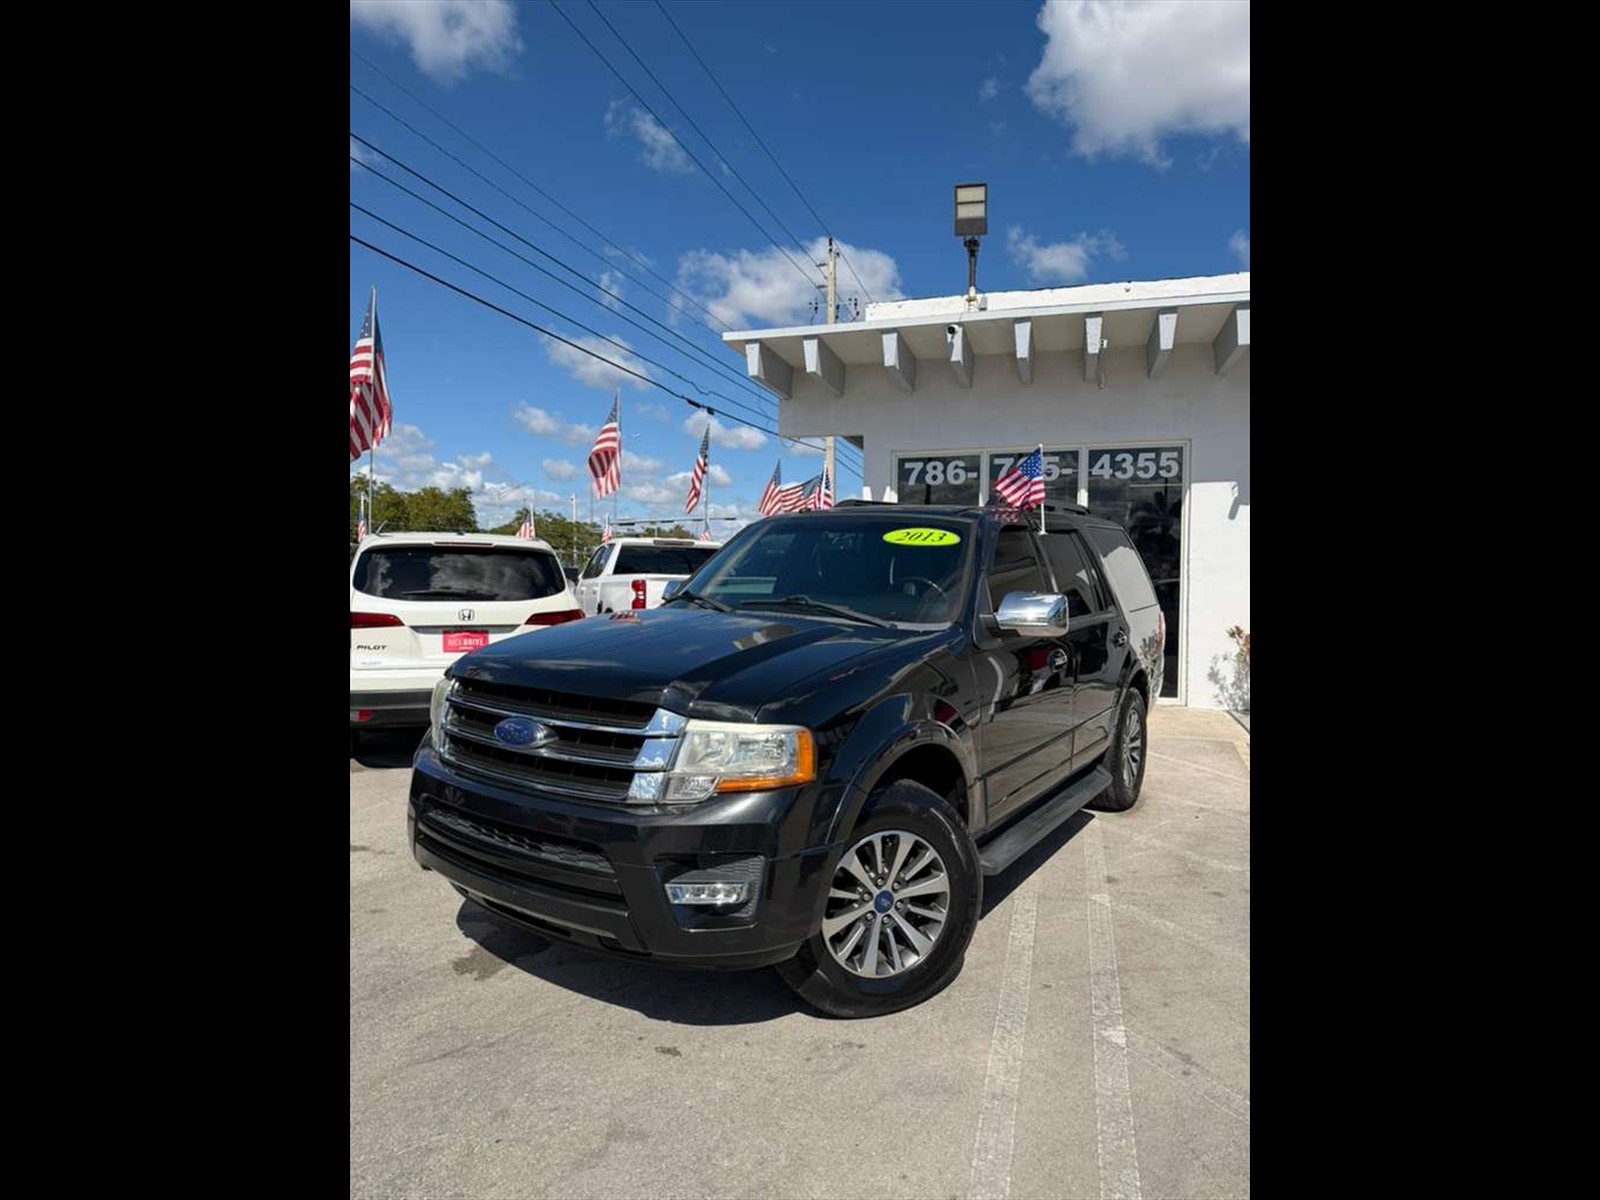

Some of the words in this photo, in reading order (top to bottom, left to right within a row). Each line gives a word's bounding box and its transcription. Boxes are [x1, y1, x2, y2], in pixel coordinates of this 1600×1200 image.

[904, 460, 978, 486] 786-
[993, 456, 1073, 482] 75-
[1092, 451, 1179, 479] 4355
[895, 530, 947, 543] 2013
[356, 643, 388, 651] PILOT
